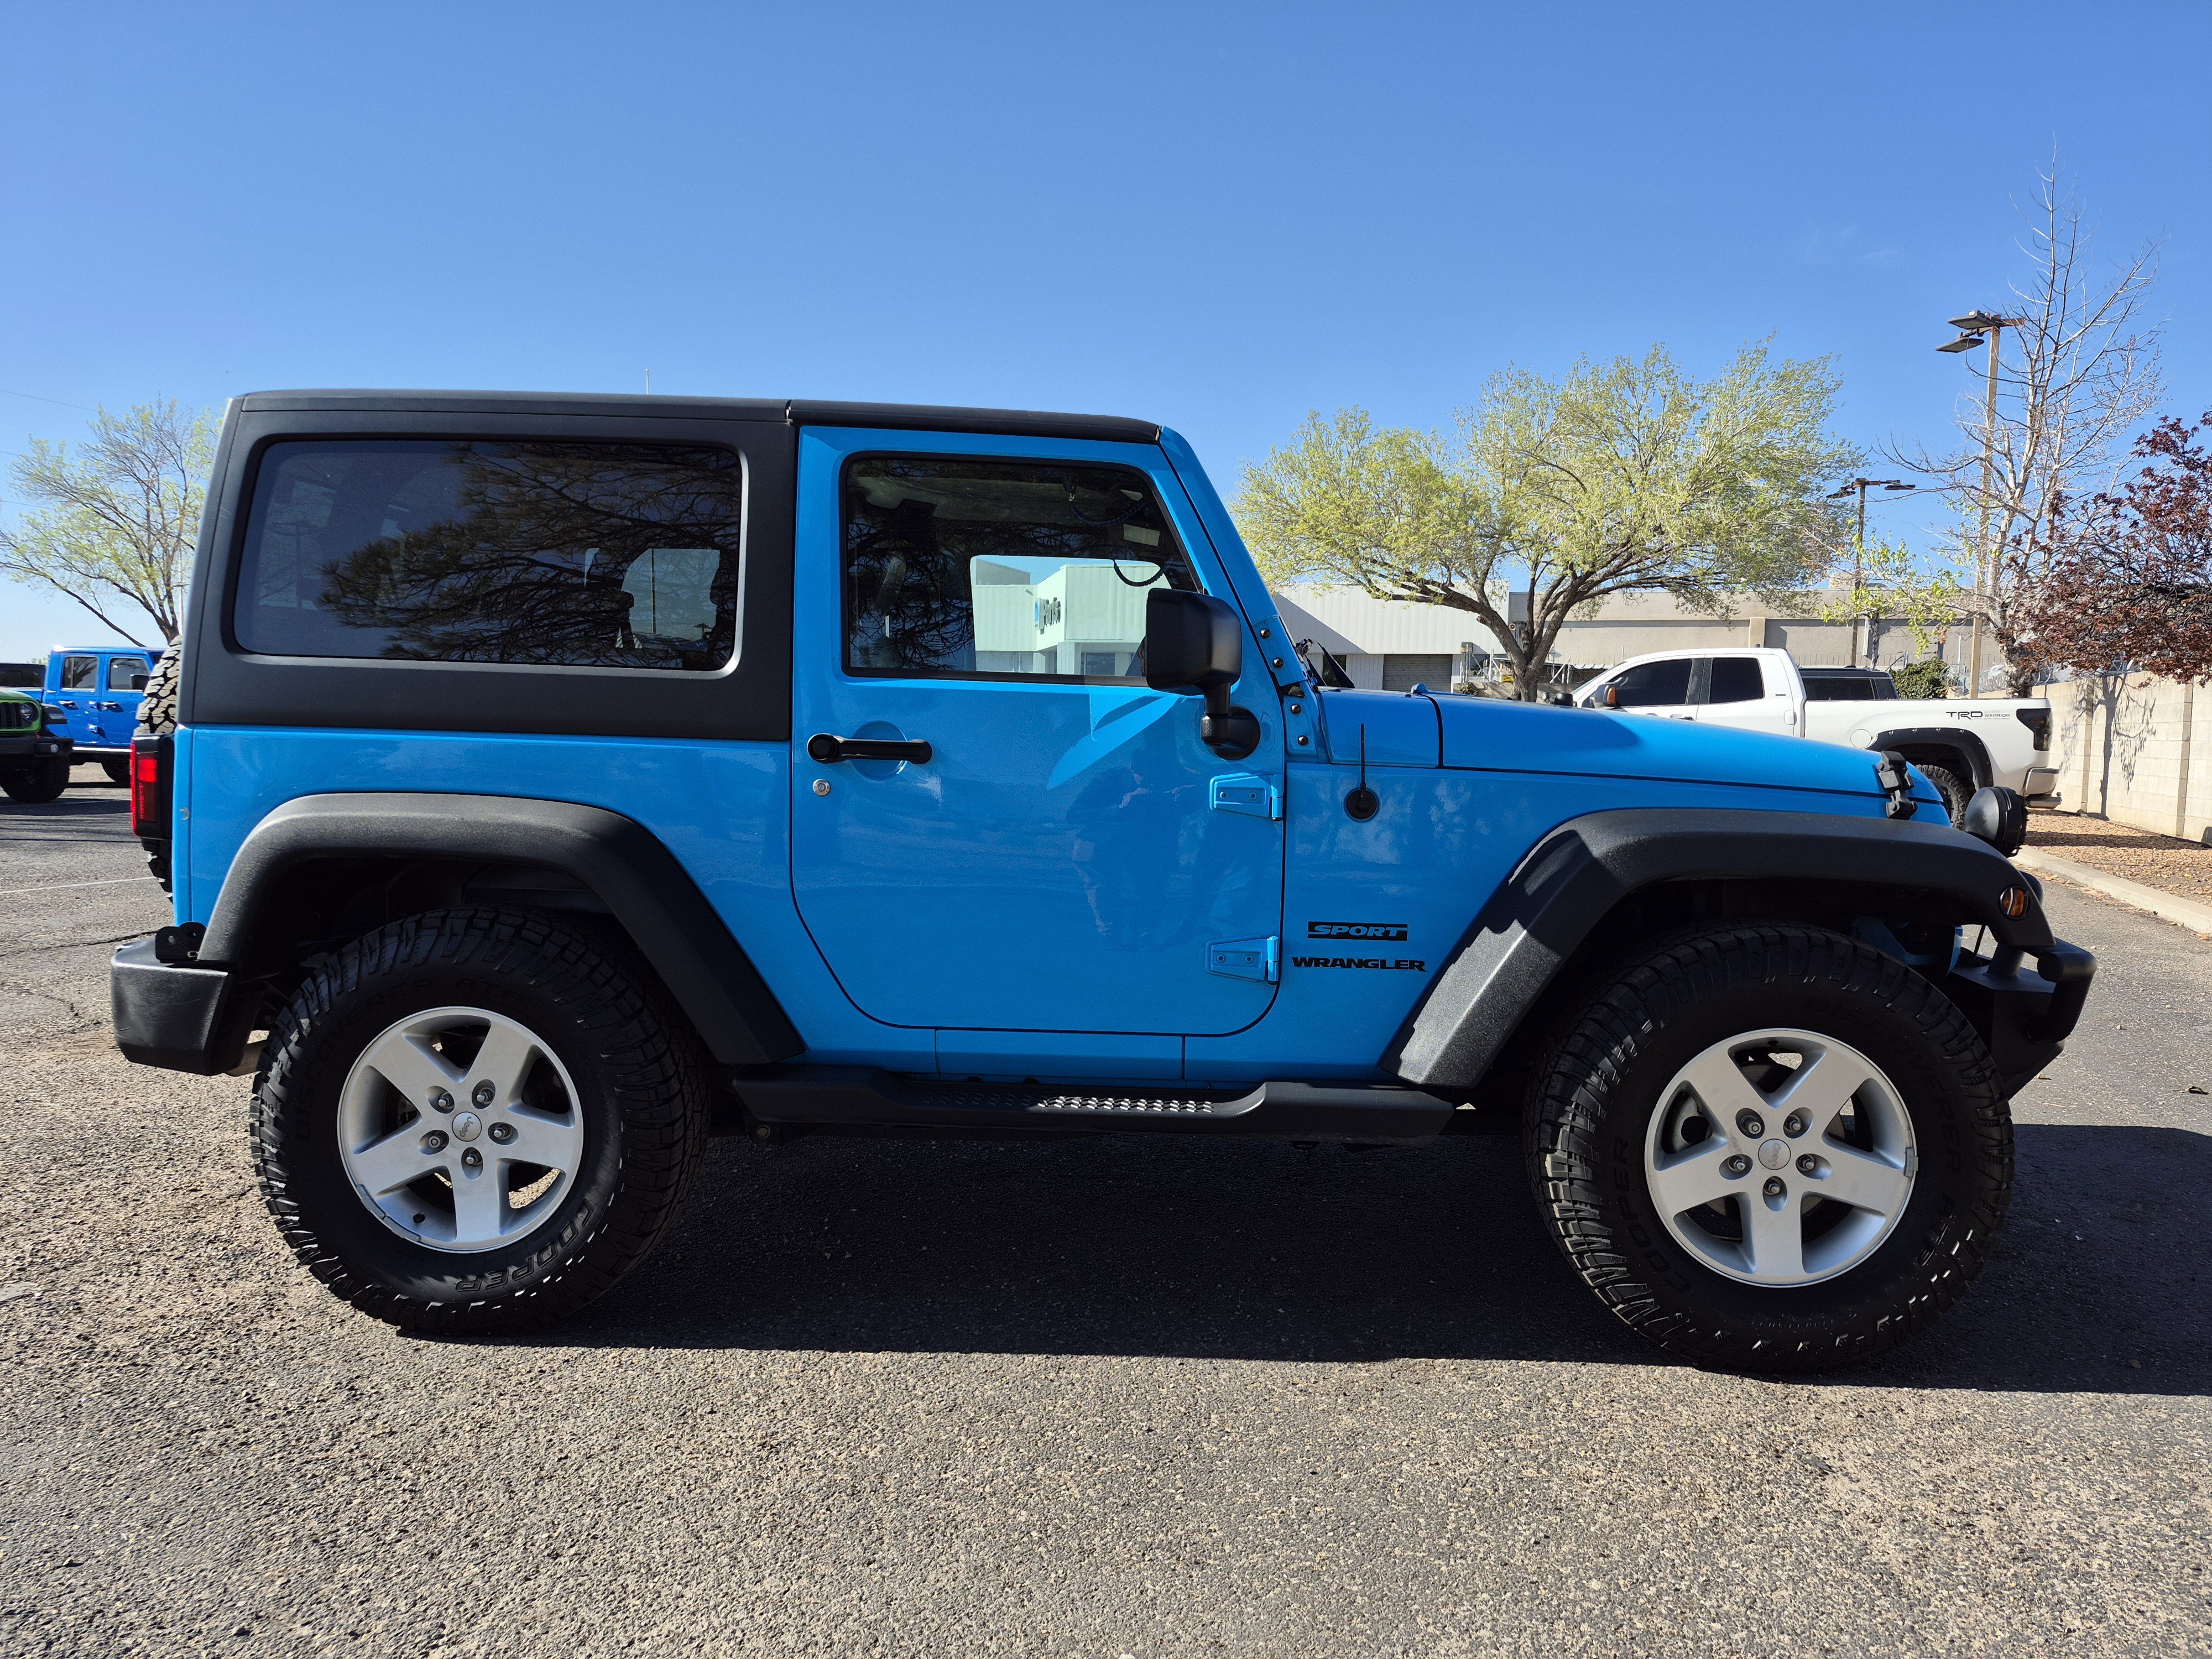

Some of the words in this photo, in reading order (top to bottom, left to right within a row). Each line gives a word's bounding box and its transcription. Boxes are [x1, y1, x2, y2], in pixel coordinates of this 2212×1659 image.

[1945, 711, 1984, 720] TRD
[1311, 924, 1407, 938] SPORT
[1292, 957, 1426, 972] WRANGLER
[459, 1116, 474, 1138] Jeep
[1768, 1142, 1781, 1167] Jeep
[1614, 1136, 1692, 1294] COOPER
[455, 1197, 594, 1293] COOPER
